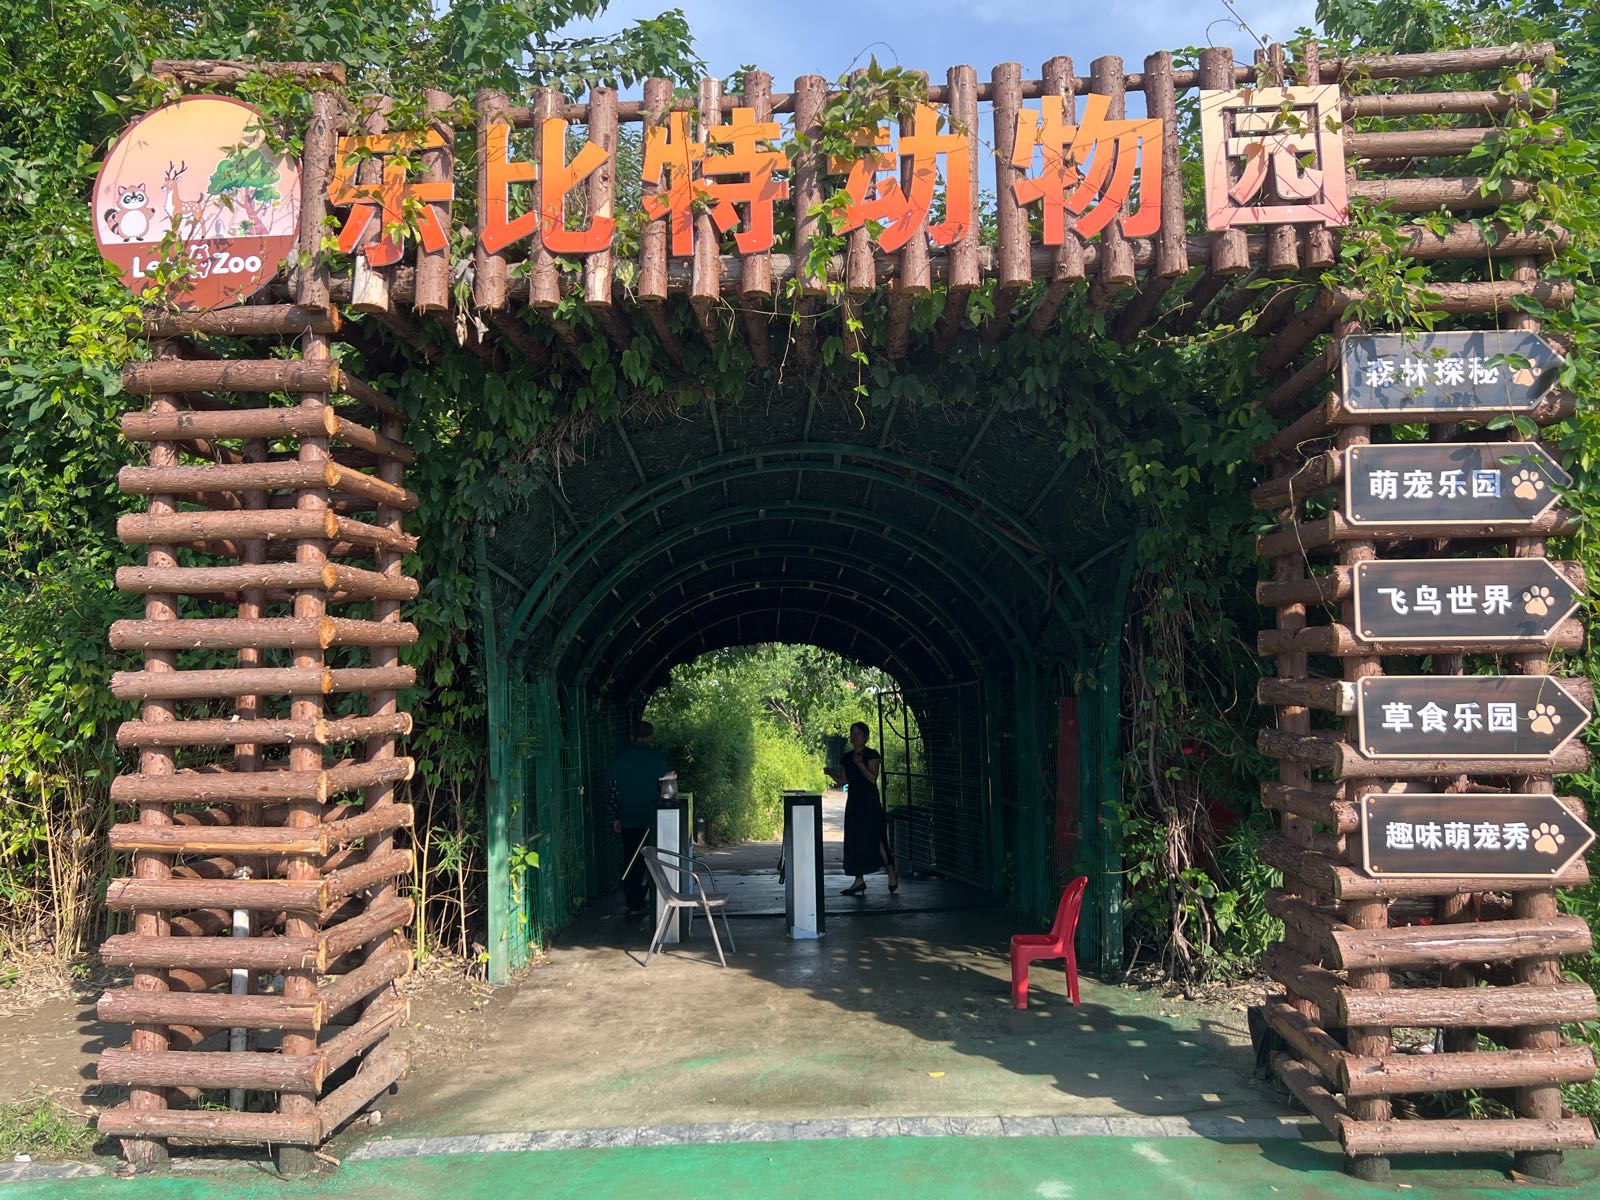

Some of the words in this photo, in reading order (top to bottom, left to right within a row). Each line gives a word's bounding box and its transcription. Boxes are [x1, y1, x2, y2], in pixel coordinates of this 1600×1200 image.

[327, 84, 1350, 267] 乐比特动物园
[212, 251, 262, 275] Zoo
[1366, 357, 1500, 388] 森林探秘
[1368, 469, 1502, 500] 萌宠乐园
[1377, 584, 1513, 616] 飞鸟世界
[1381, 701, 1519, 733] 草食乐园
[1385, 821, 1530, 850] 趣味萌宠秀
